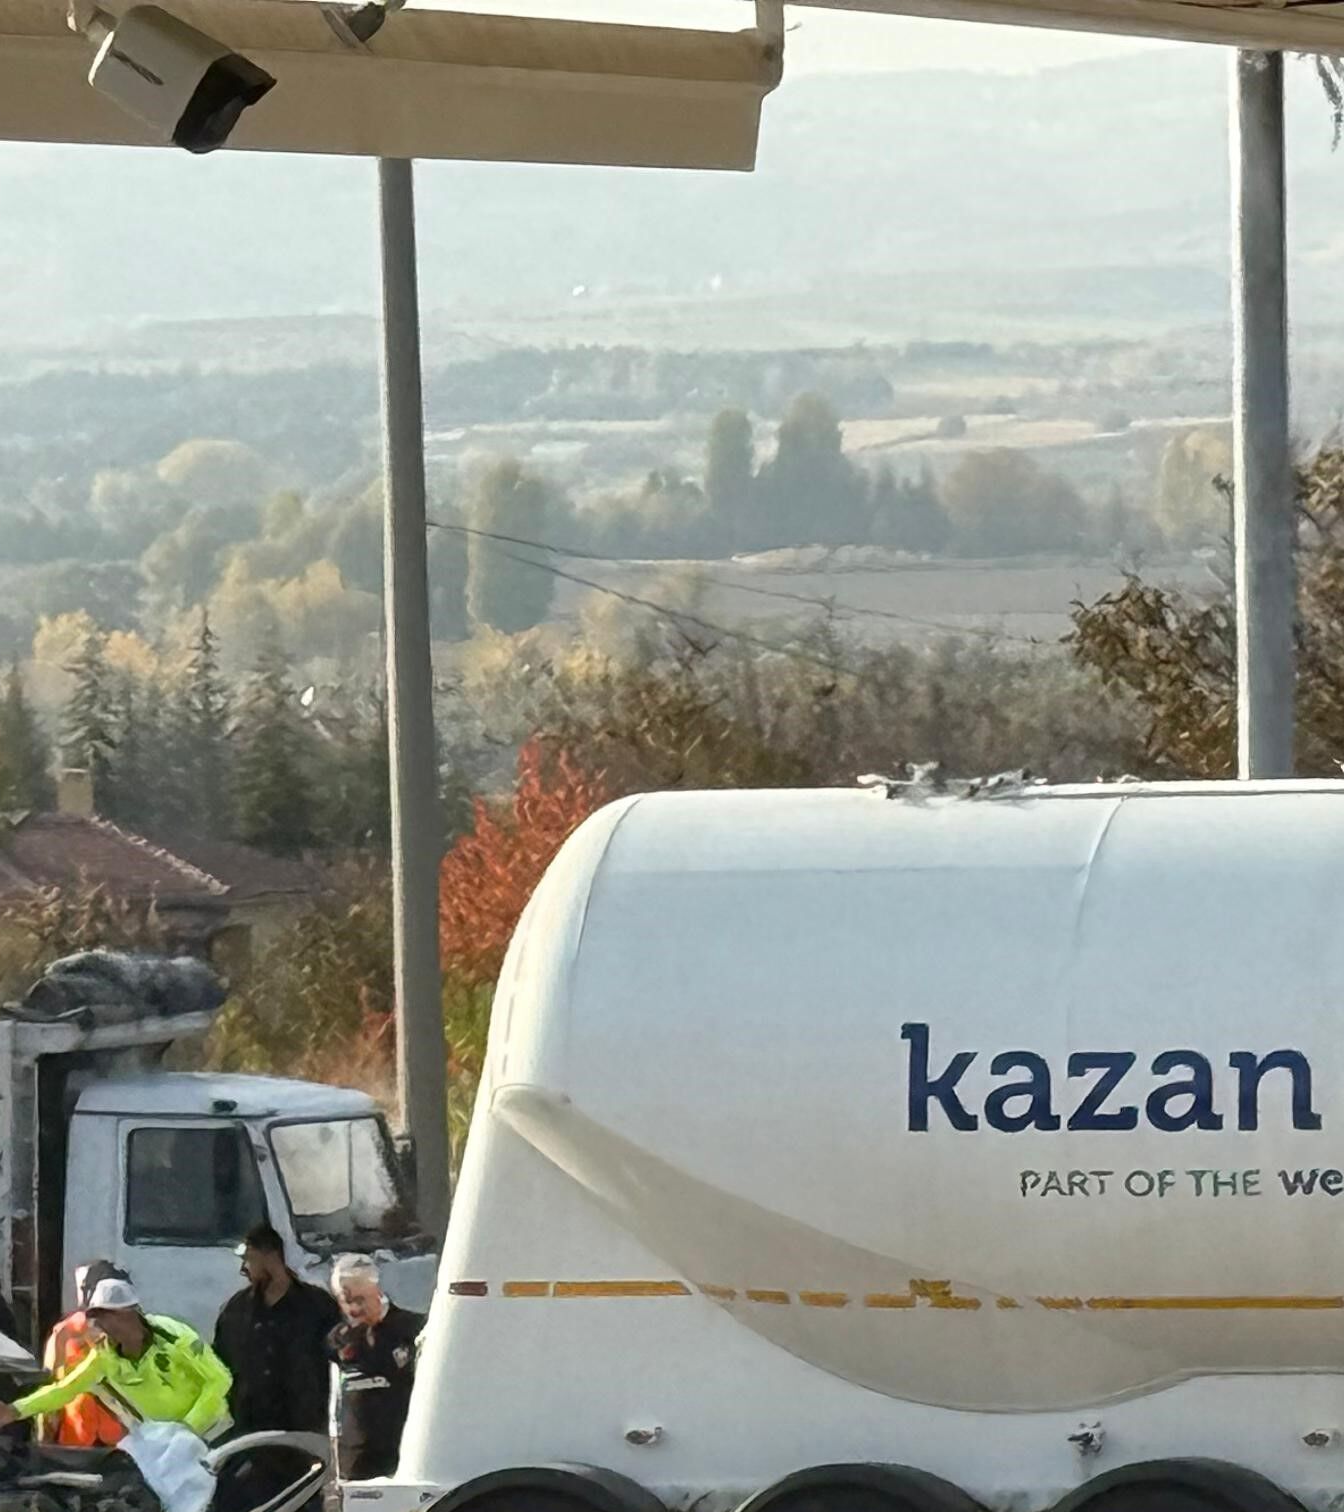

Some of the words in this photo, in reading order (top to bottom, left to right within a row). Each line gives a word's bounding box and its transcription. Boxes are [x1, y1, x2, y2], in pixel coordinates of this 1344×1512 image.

[901, 1021, 1322, 1131] kazan
[1019, 1169, 1114, 1197] PART
[1124, 1169, 1176, 1197] OF
[1186, 1168, 1261, 1197] THE
[1278, 1167, 1344, 1196] we
